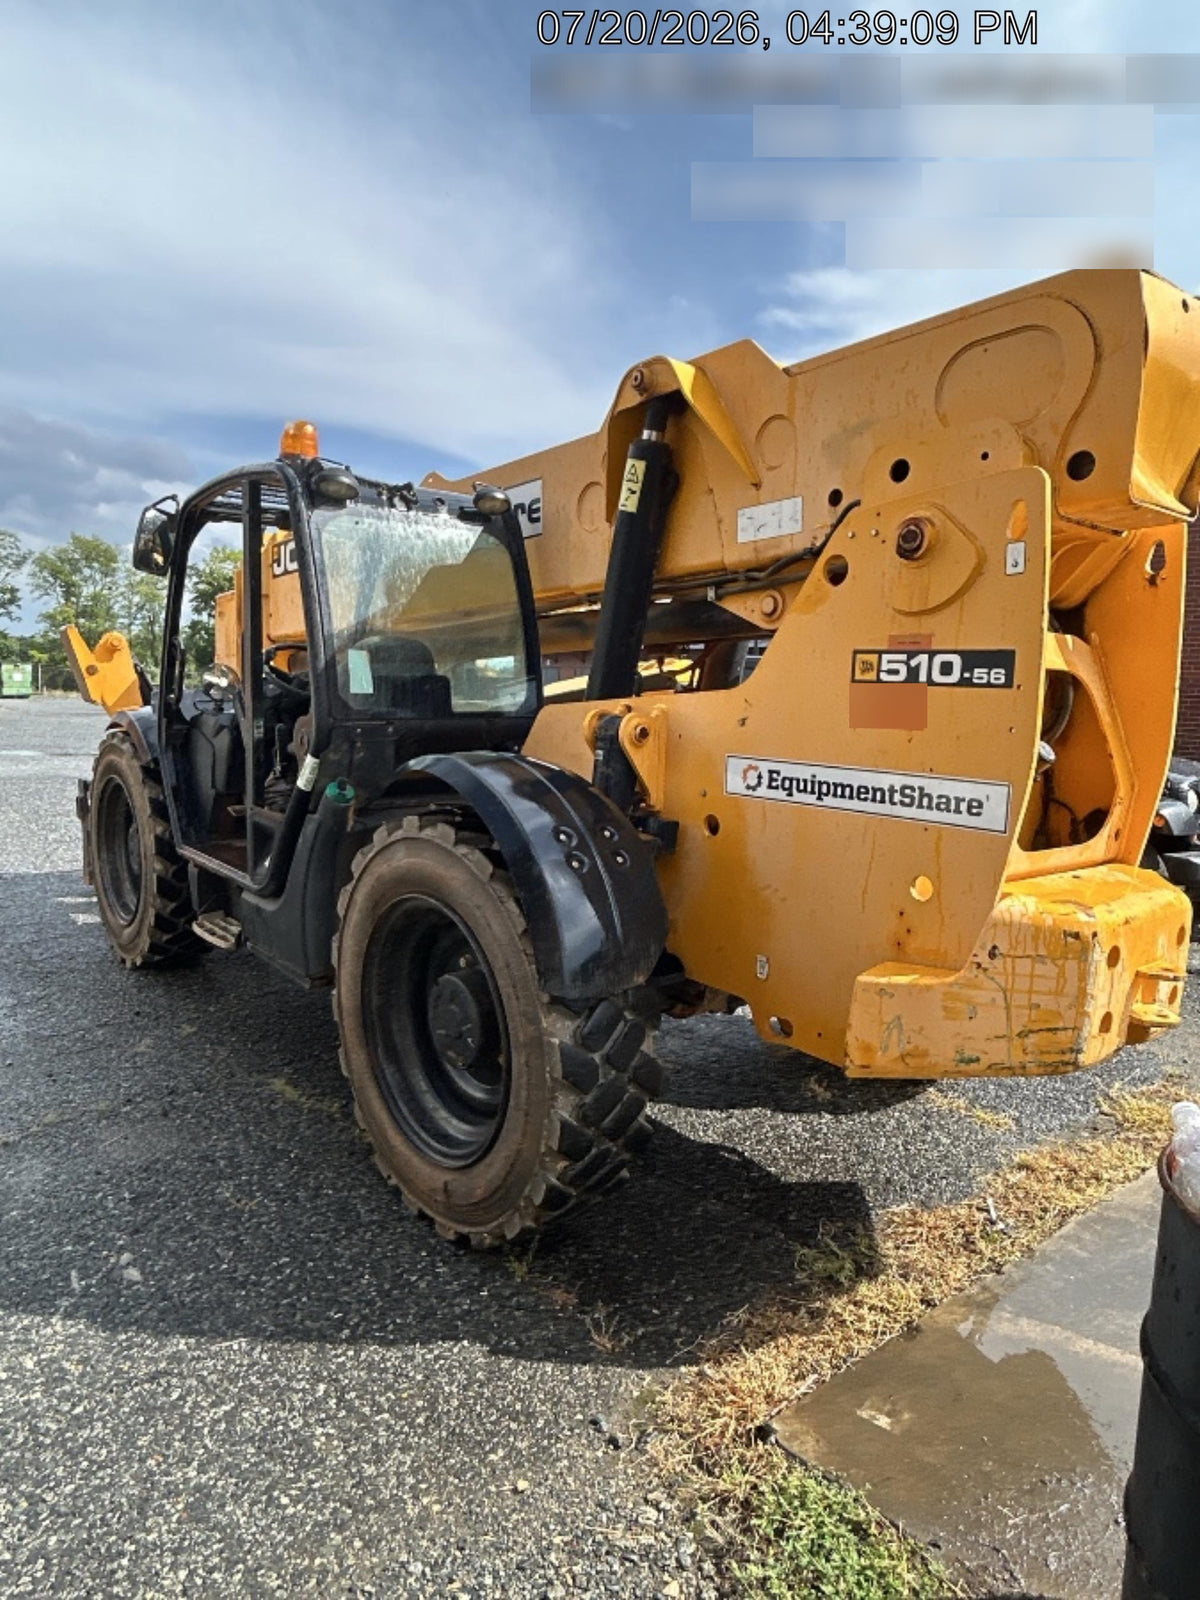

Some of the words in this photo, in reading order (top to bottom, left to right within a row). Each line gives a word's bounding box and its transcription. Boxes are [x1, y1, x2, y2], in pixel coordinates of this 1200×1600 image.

[273, 540, 299, 575] JC
[879, 653, 1006, 684] 510-56
[766, 769, 984, 817] EquipmentShare
